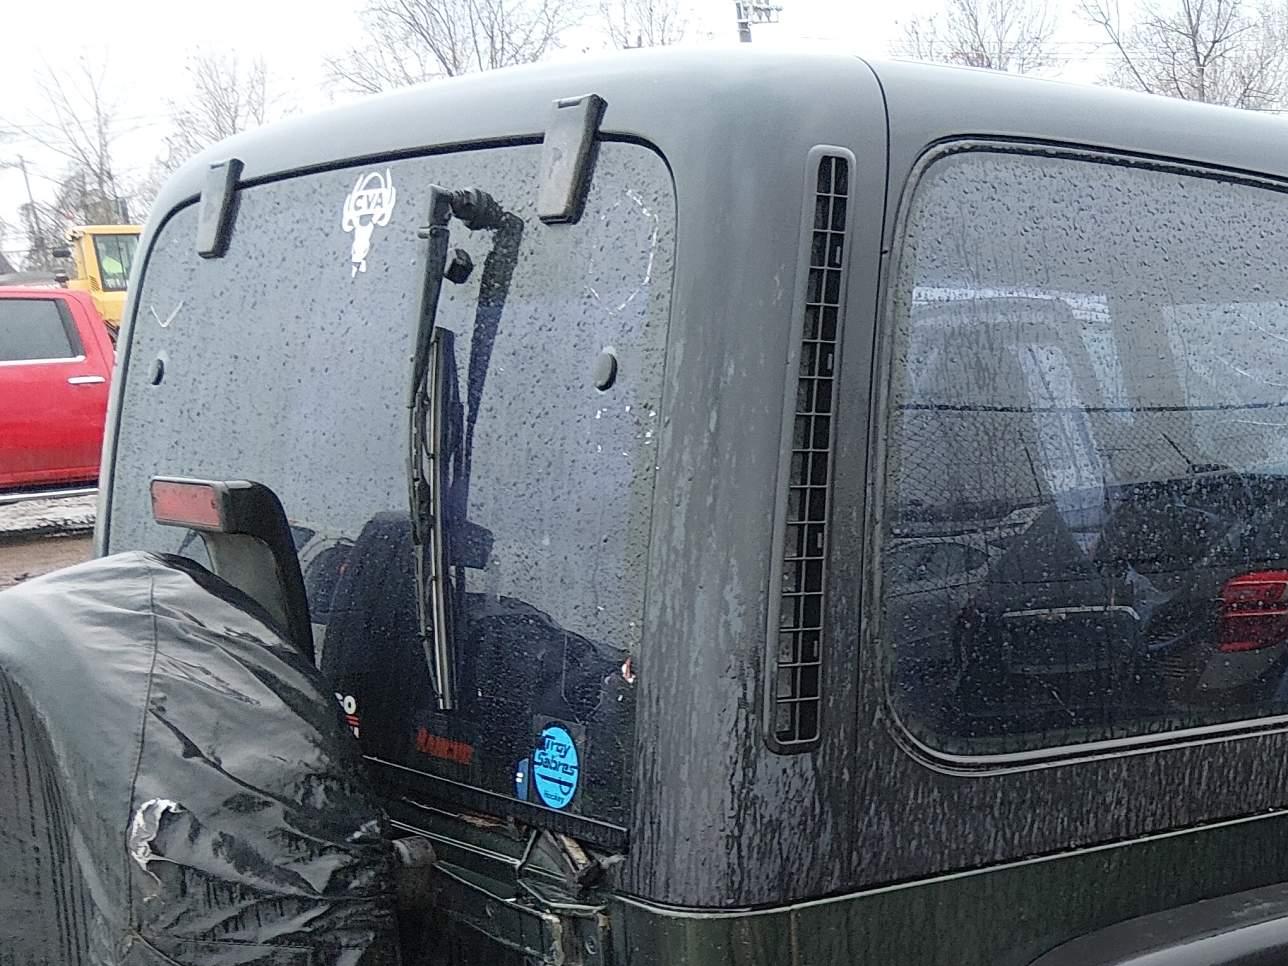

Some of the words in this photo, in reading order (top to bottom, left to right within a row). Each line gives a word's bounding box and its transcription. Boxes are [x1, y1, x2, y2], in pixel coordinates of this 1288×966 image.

[353, 192, 384, 212] CVA
[540, 734, 571, 758] Troy
[533, 752, 579, 776] Sabres
